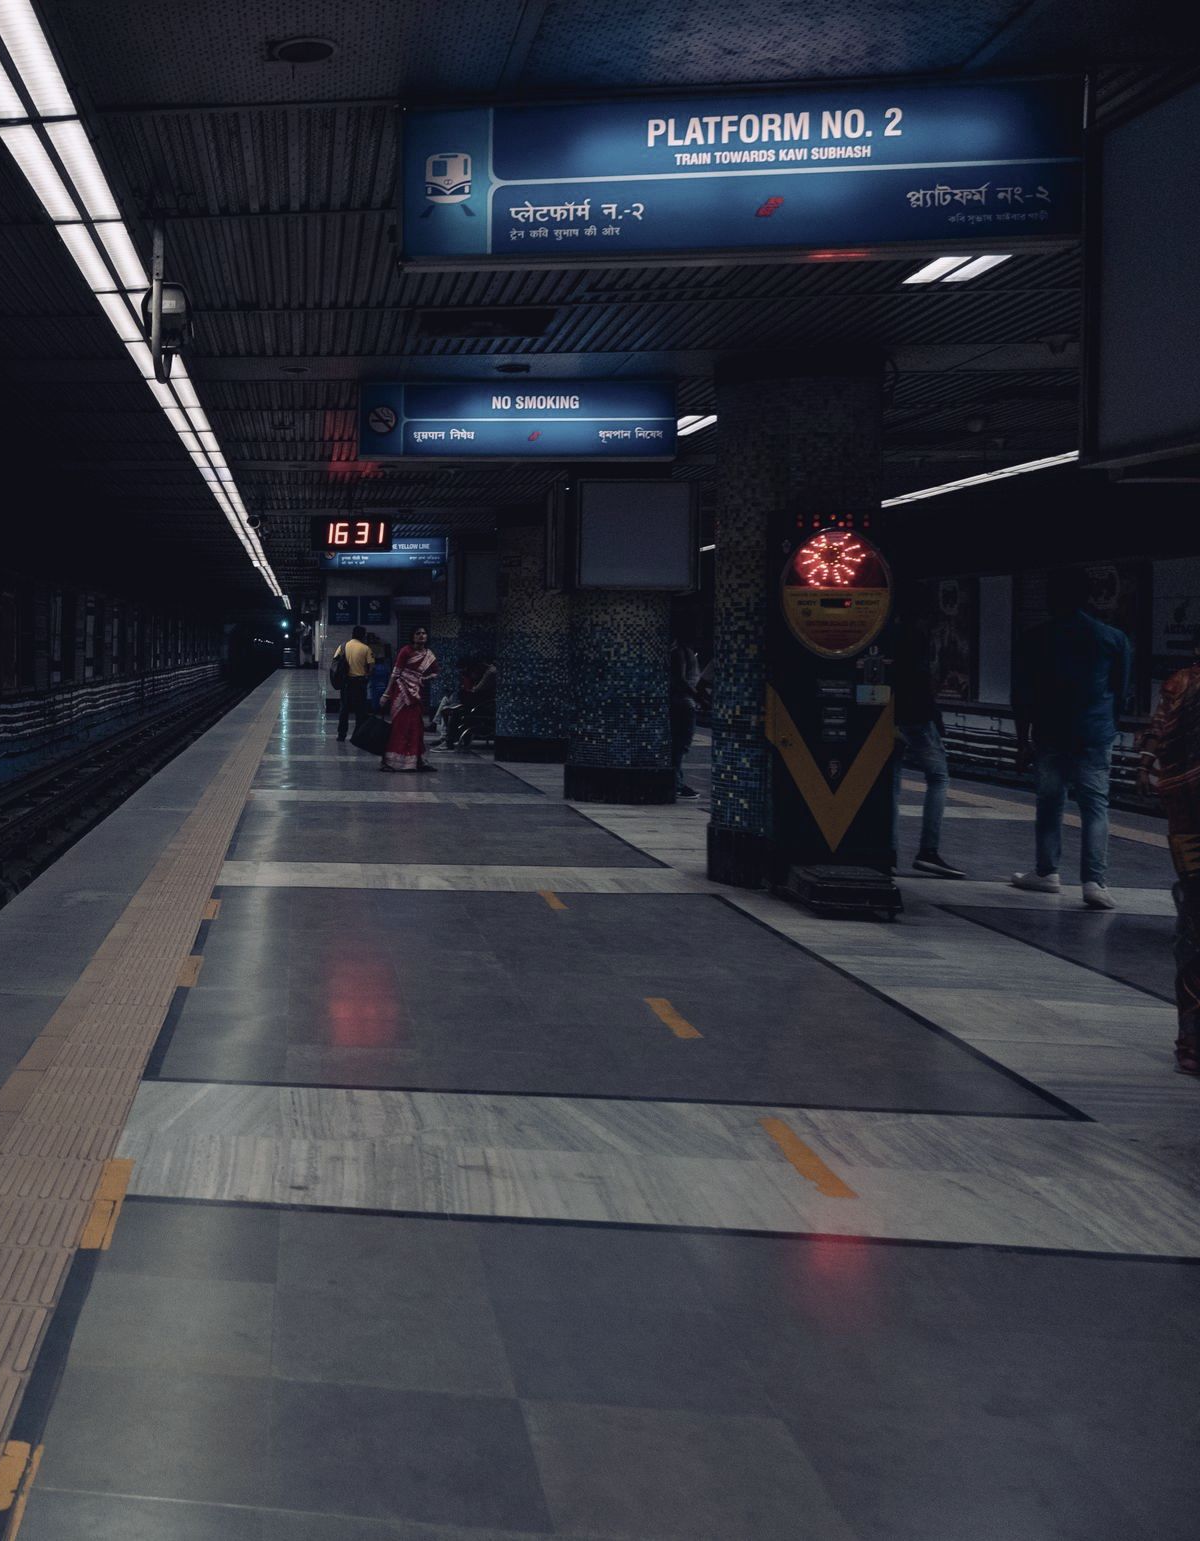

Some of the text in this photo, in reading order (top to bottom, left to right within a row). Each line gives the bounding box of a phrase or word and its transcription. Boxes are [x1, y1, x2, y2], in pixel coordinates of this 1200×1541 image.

[647, 107, 903, 148] PLATFORM NO. 2
[674, 145, 871, 166] TRAIN TOWARDS KAVI SUBHASH
[508, 198, 592, 223] प्लेटफॉर्म
[529, 226, 549, 239] कवि
[584, 224, 597, 238] की
[491, 394, 580, 410] NO SMOKING
